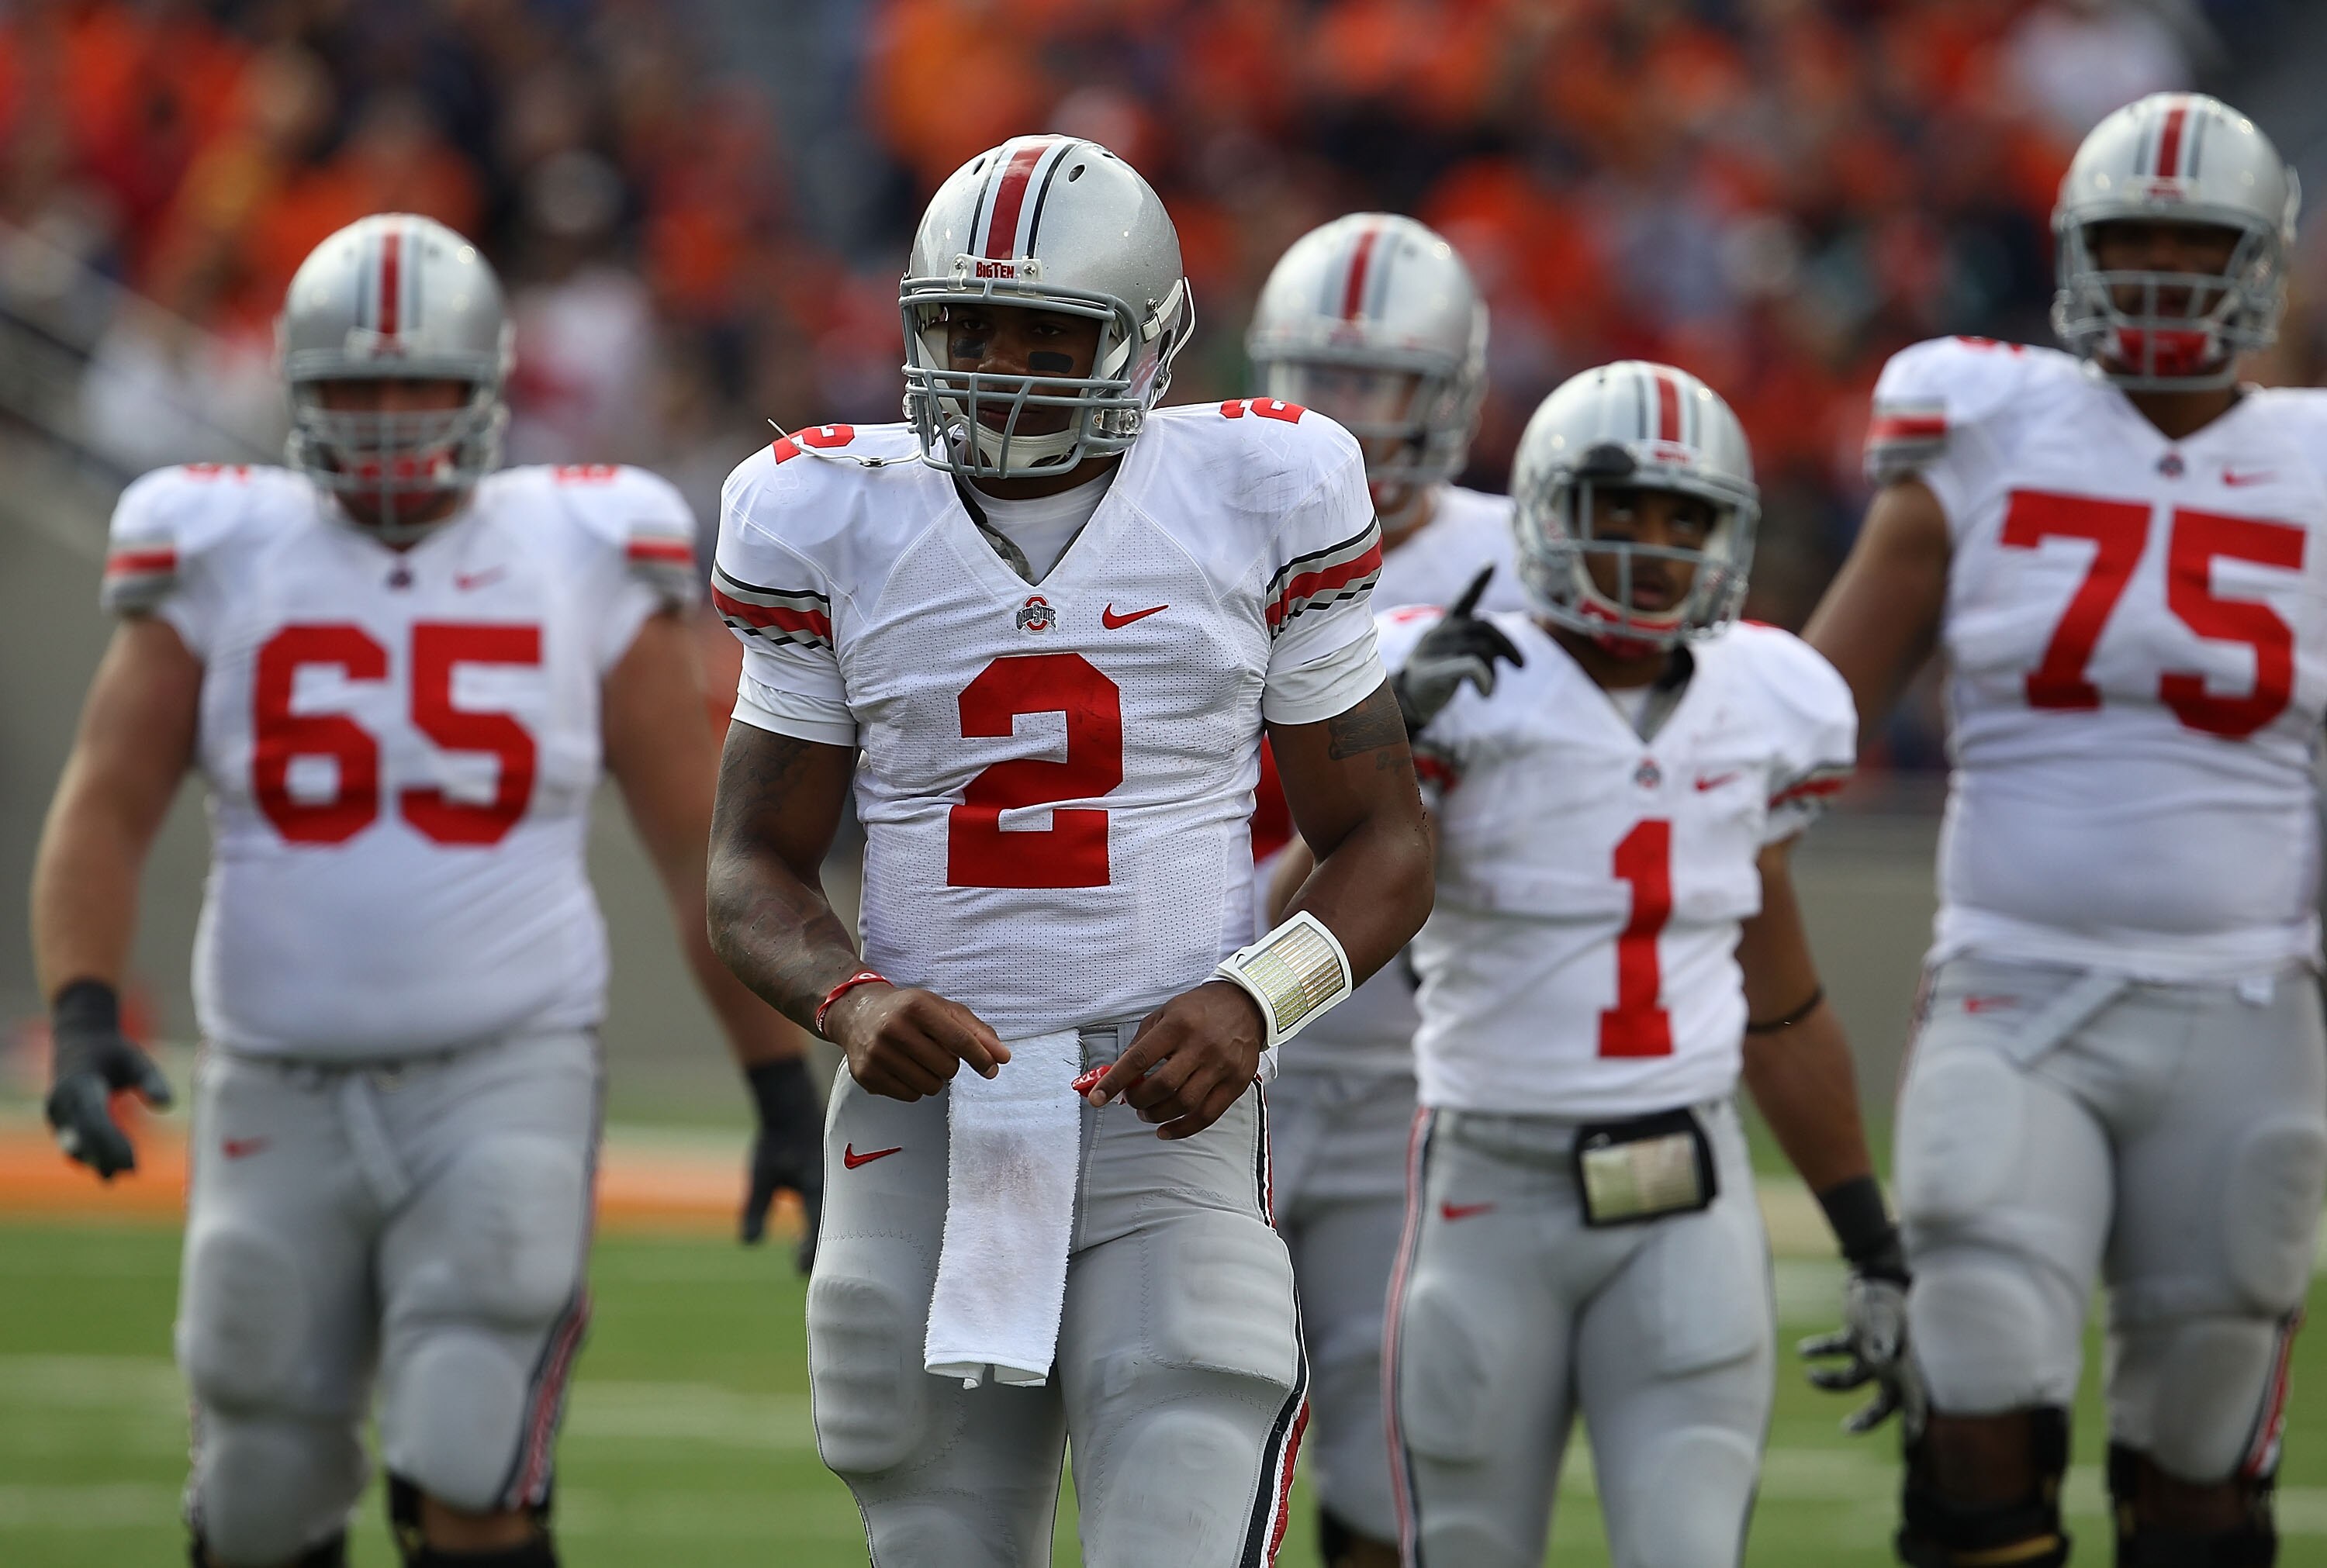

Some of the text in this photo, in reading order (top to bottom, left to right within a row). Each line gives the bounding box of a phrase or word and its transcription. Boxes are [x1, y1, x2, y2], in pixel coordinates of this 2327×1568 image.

[2000, 489, 2307, 737] 75
[252, 622, 542, 847] 65
[947, 652, 1124, 889] 2
[1596, 818, 1675, 1059] 1
